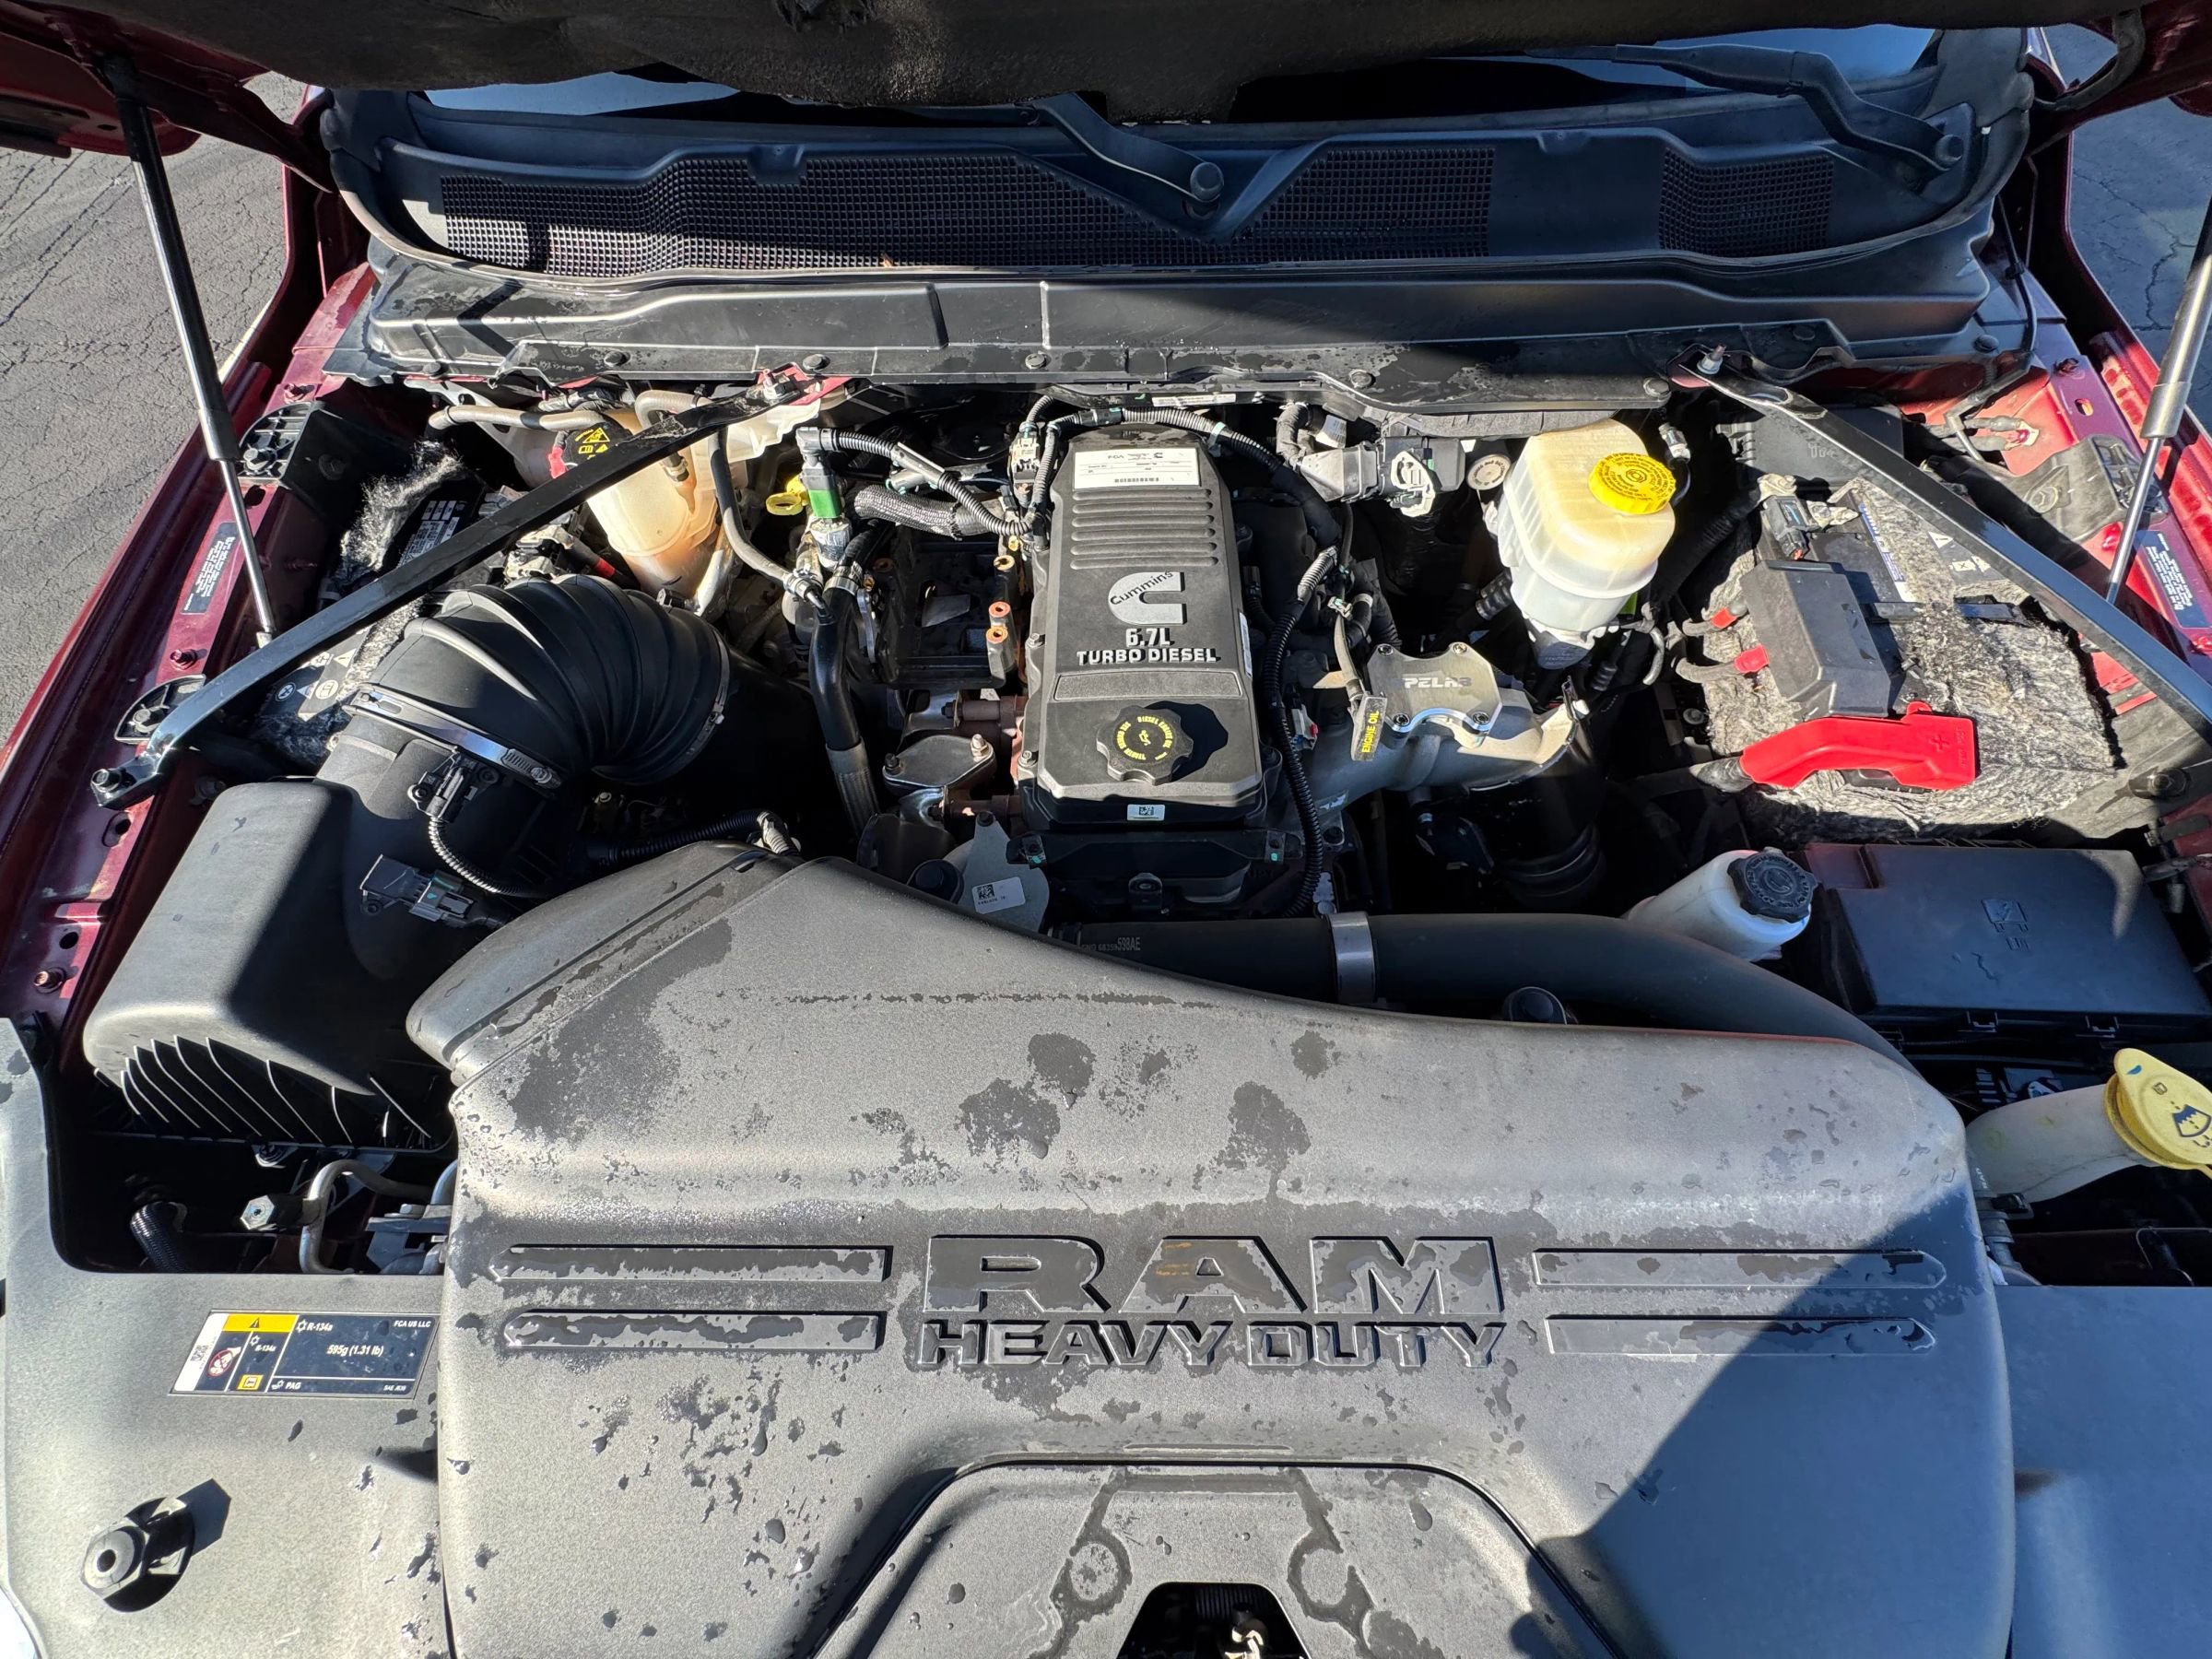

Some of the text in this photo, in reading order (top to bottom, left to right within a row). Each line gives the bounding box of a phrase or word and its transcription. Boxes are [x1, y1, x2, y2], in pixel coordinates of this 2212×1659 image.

[1110, 570, 1173, 606] Cummins
[1125, 628, 1173, 647] 6.7L
[1077, 648, 1219, 665] TURBO DIESEL
[1391, 676, 1472, 689] PELAB
[1361, 710, 1381, 753] ENGINE OIL
[923, 1235, 1505, 1314] RAM
[306, 1322, 334, 1332] R-134a
[418, 1320, 431, 1328] LLC
[326, 1344, 384, 1357] 595g (1.31 lb)
[918, 1320, 1507, 1368] HEAVY DUTY
[285, 1382, 302, 1390] PAG
